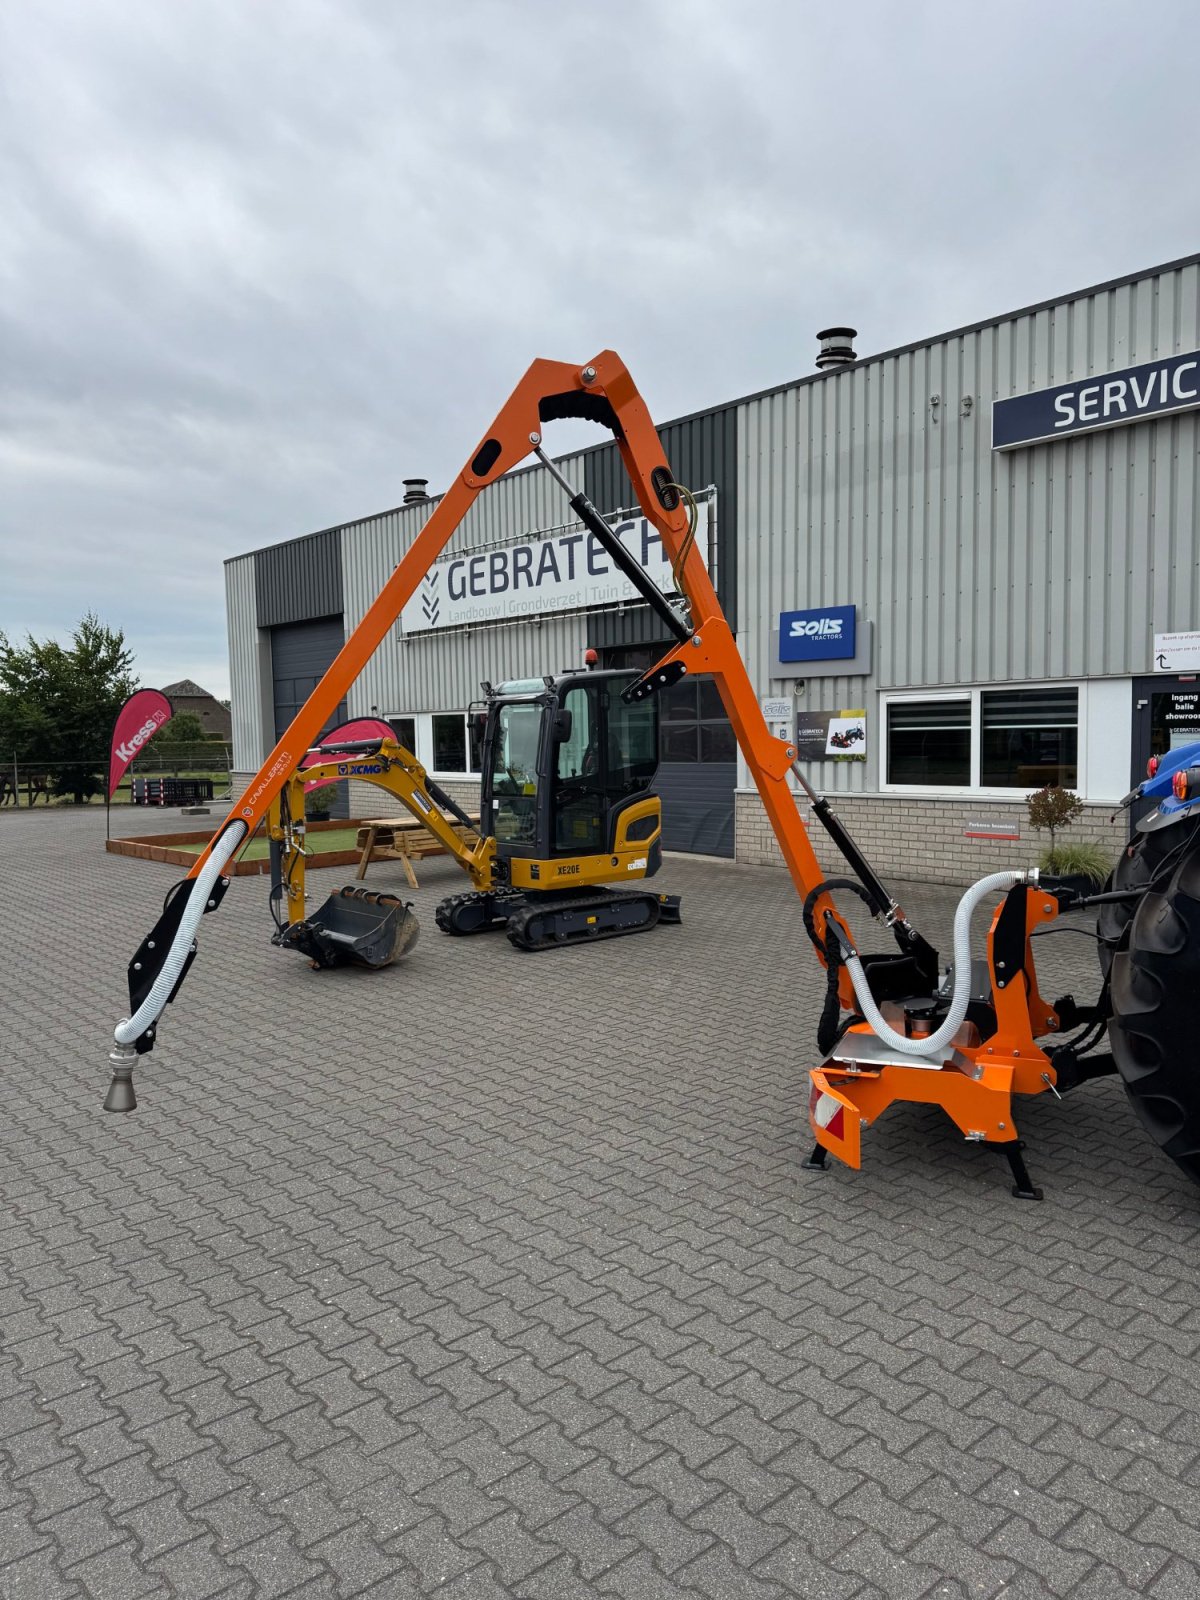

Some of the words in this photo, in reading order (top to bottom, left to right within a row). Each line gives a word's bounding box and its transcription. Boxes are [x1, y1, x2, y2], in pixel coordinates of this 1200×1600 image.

[1054, 362, 1198, 427] SERVIC
[449, 606, 501, 623] Landbouw
[508, 591, 582, 614] Grondverzet
[590, 584, 618, 601] Tuin
[622, 581, 633, 596] &
[811, 633, 843, 641] TRACTORS
[1171, 694, 1198, 702] Ingang
[1165, 712, 1200, 720] showroo
[115, 719, 157, 762] Kress
[350, 764, 382, 775] XCMG
[557, 864, 580, 875] XE20E
